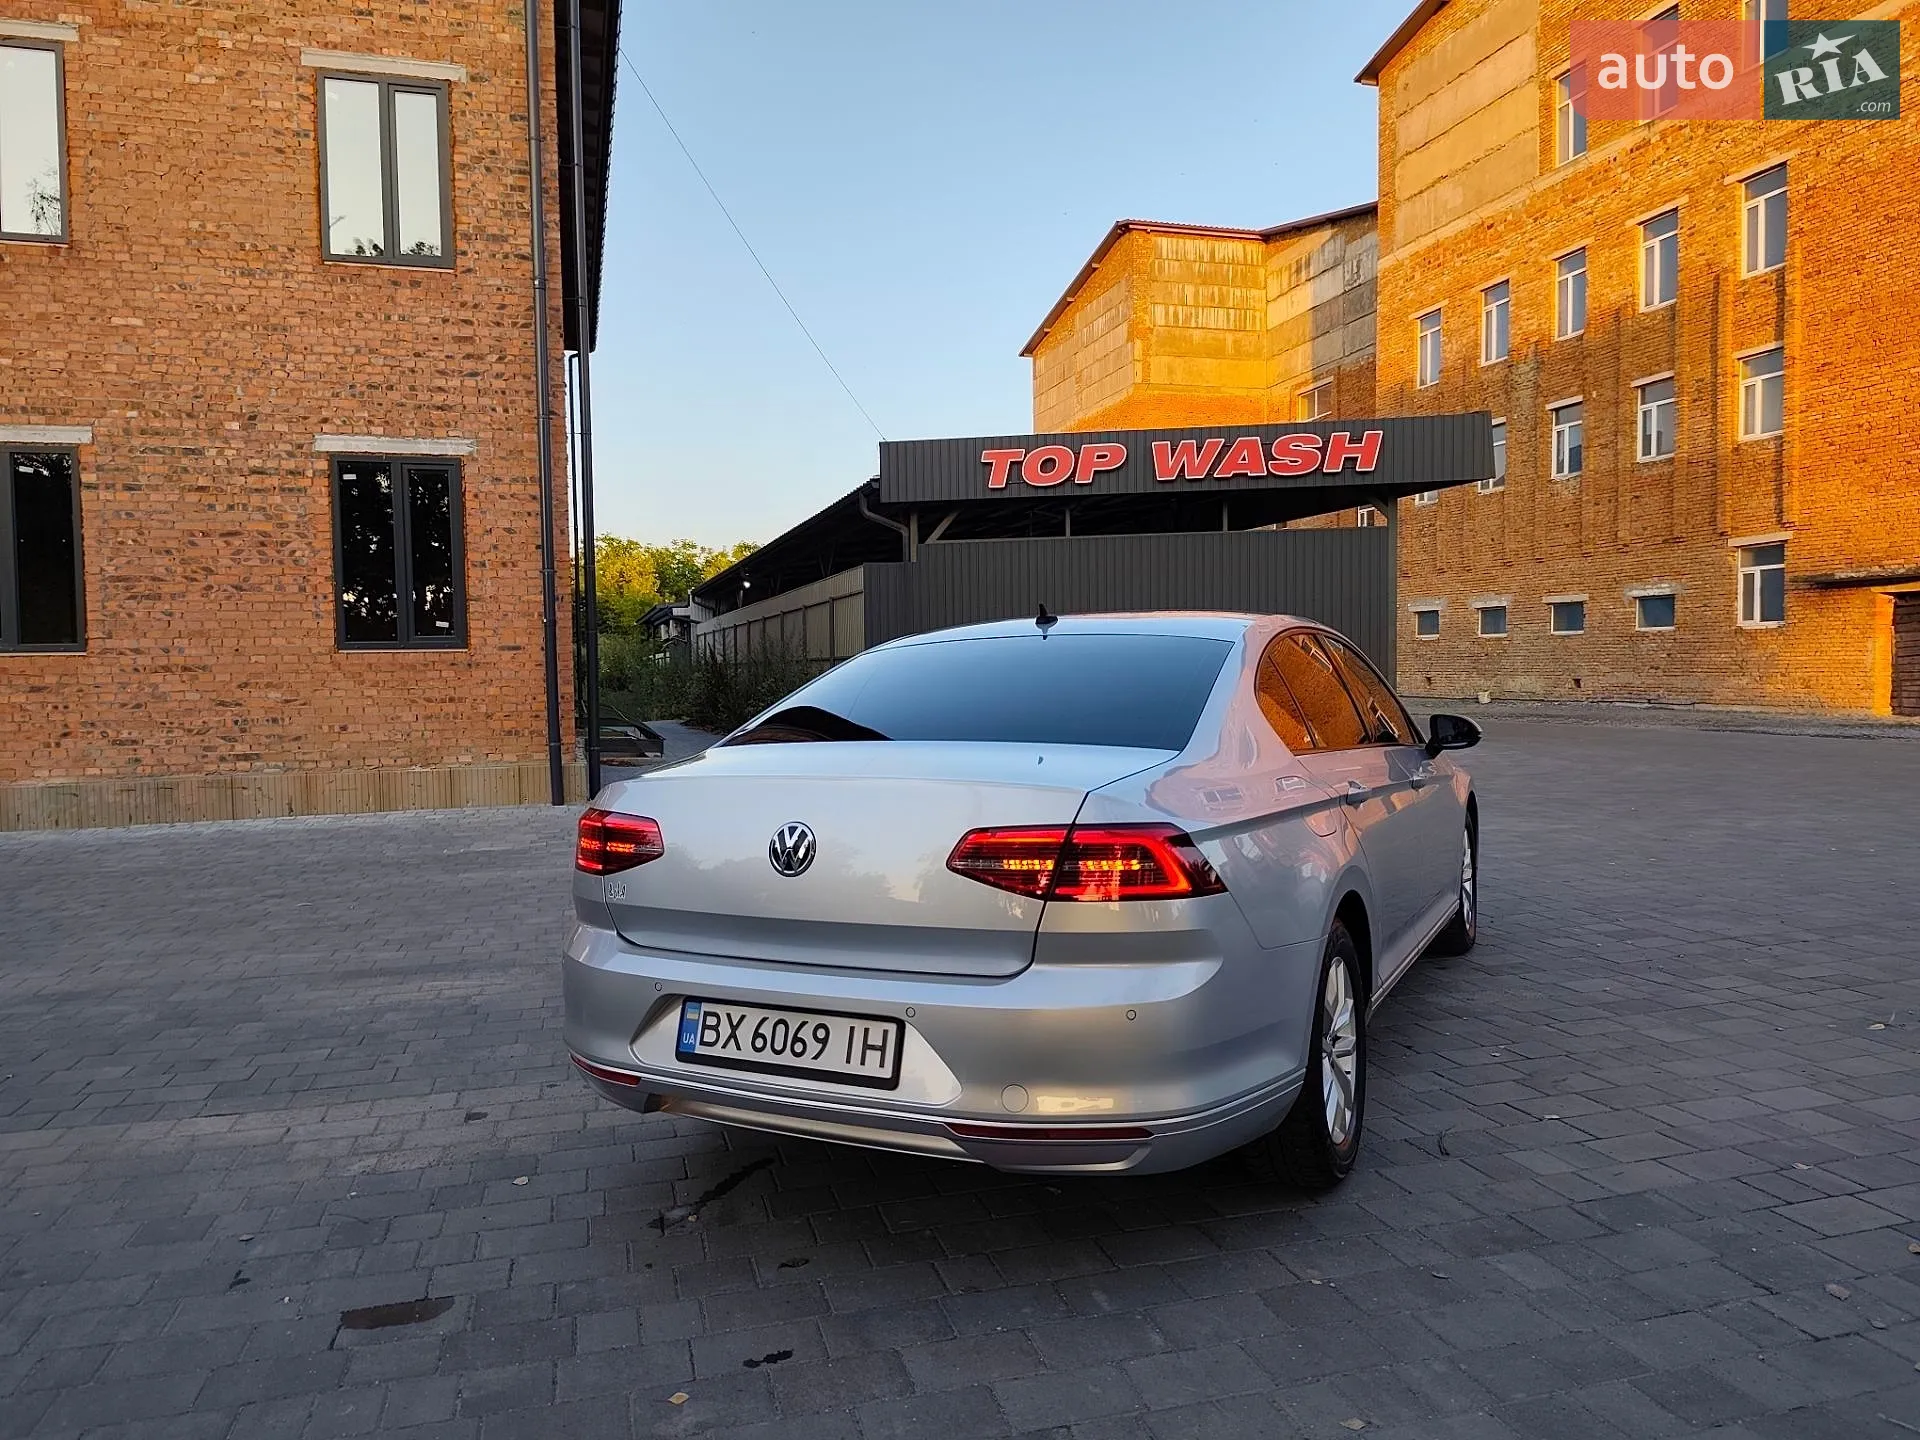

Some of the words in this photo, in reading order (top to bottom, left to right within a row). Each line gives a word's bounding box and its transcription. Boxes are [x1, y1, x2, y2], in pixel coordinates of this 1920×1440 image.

[981, 443, 1127, 488] TOP
[1152, 430, 1383, 480] WASH
[682, 1032, 695, 1045] UA
[699, 1010, 747, 1051] BX
[751, 1016, 830, 1060] 6069
[845, 1025, 889, 1068] IH
